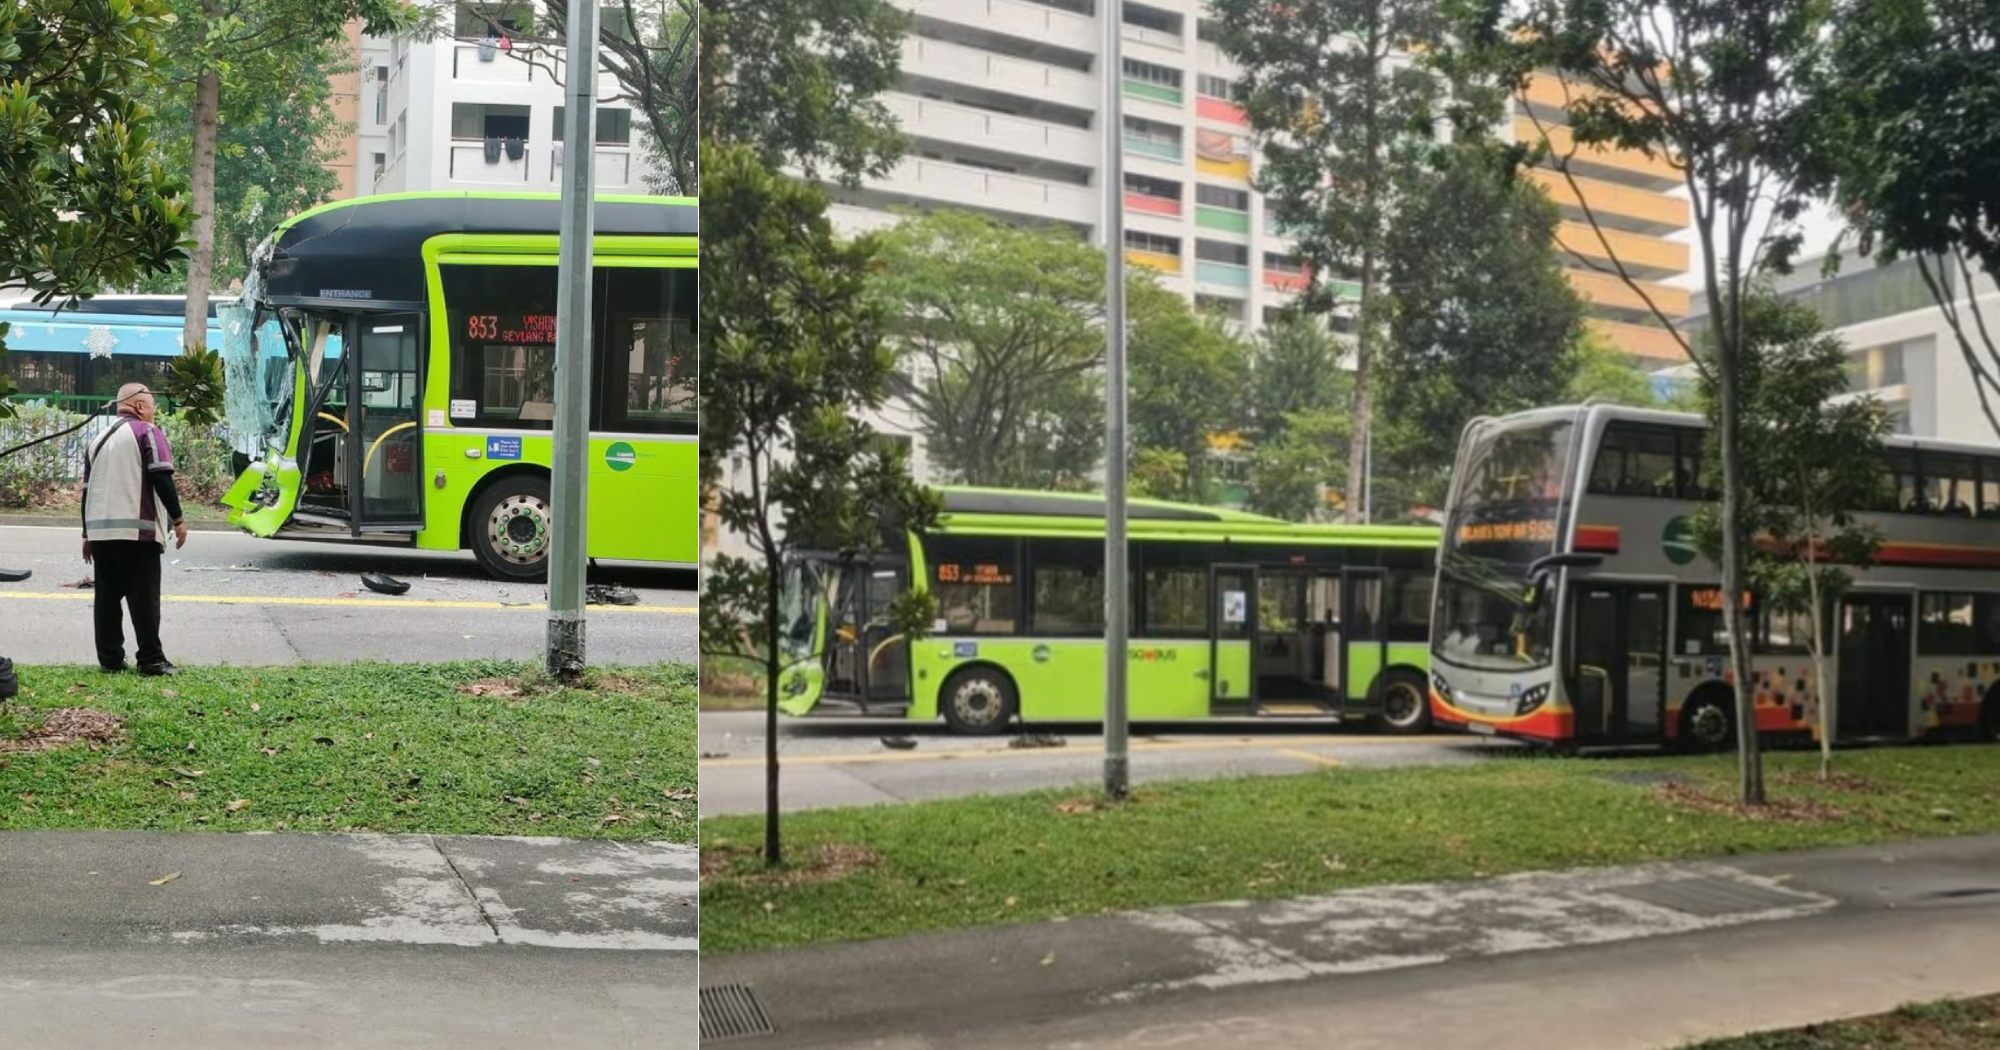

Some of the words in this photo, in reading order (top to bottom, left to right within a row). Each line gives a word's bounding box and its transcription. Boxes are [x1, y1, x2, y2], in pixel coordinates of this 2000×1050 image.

[320, 289, 372, 298] ENTRANCE
[469, 315, 498, 339] 853
[502, 331, 544, 342] GEYLANG
